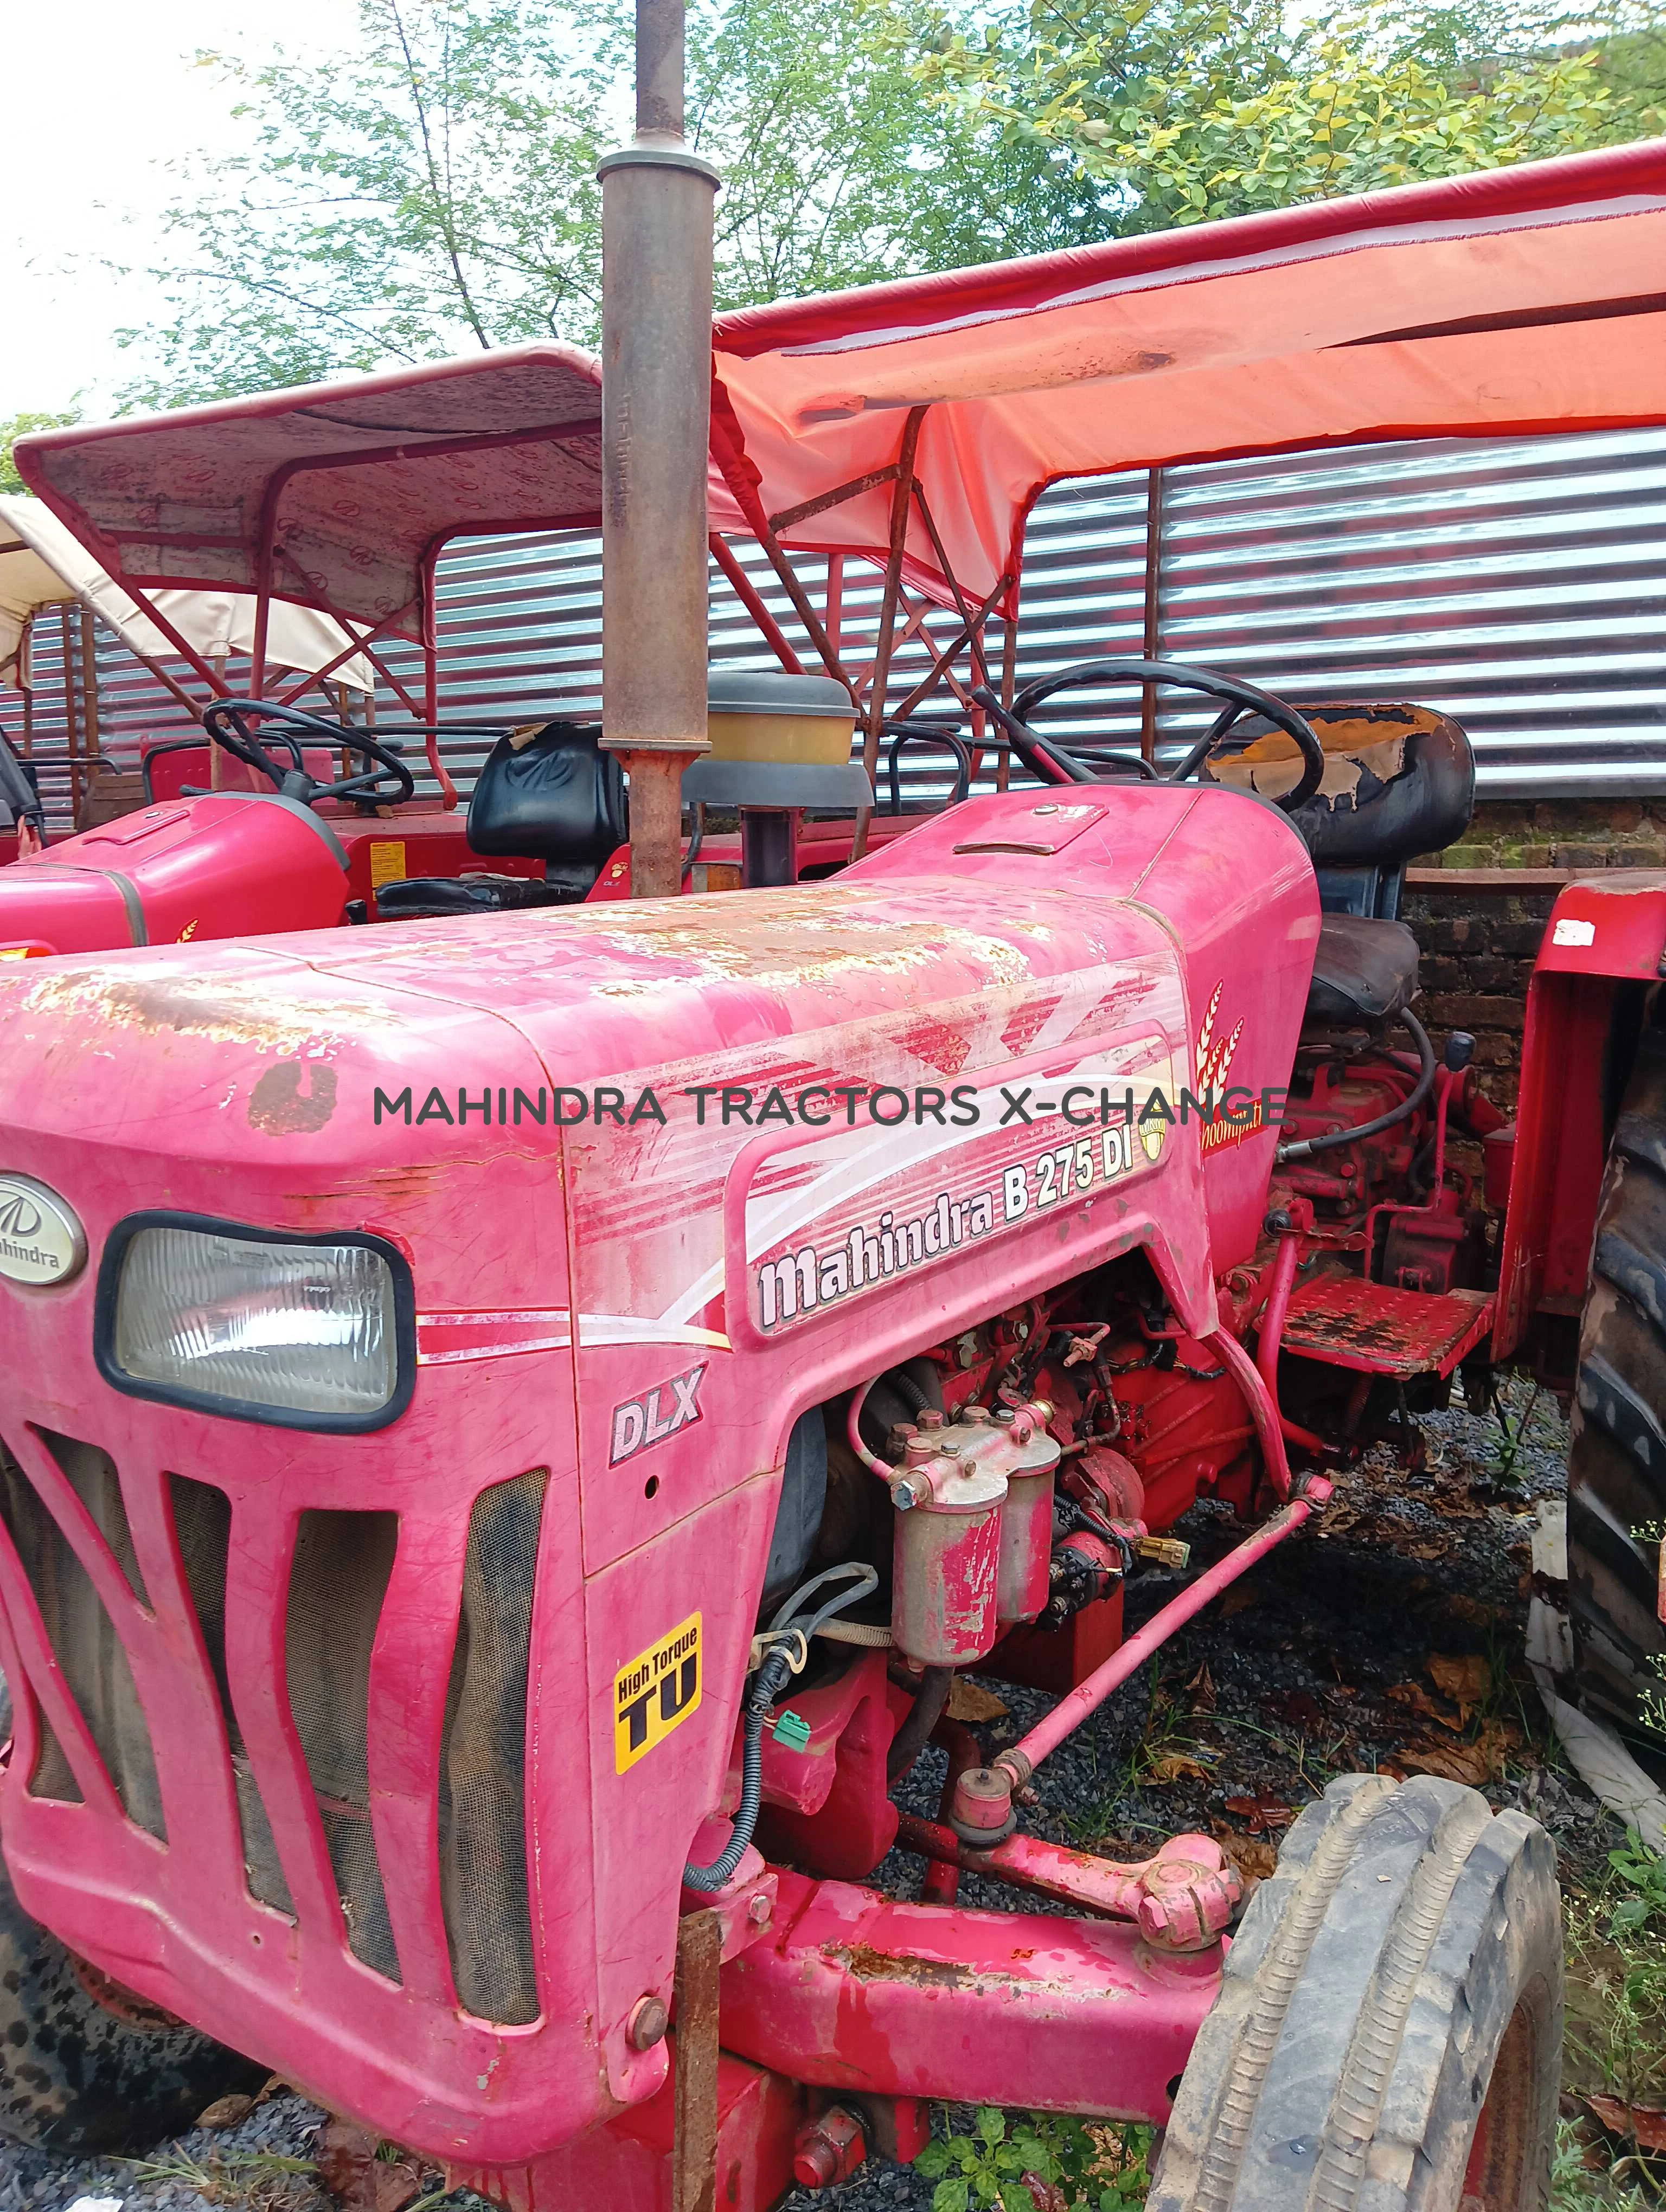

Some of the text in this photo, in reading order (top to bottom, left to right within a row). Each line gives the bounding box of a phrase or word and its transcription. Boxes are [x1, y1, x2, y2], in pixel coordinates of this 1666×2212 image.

[1003, 1164, 1029, 1223] B
[1036, 1137, 1094, 1209] 275
[1102, 1123, 1132, 1179] DI
[611, 1366, 704, 1465] DLX
[618, 1627, 697, 1703] High Torque
[618, 1651, 697, 1753] TU
